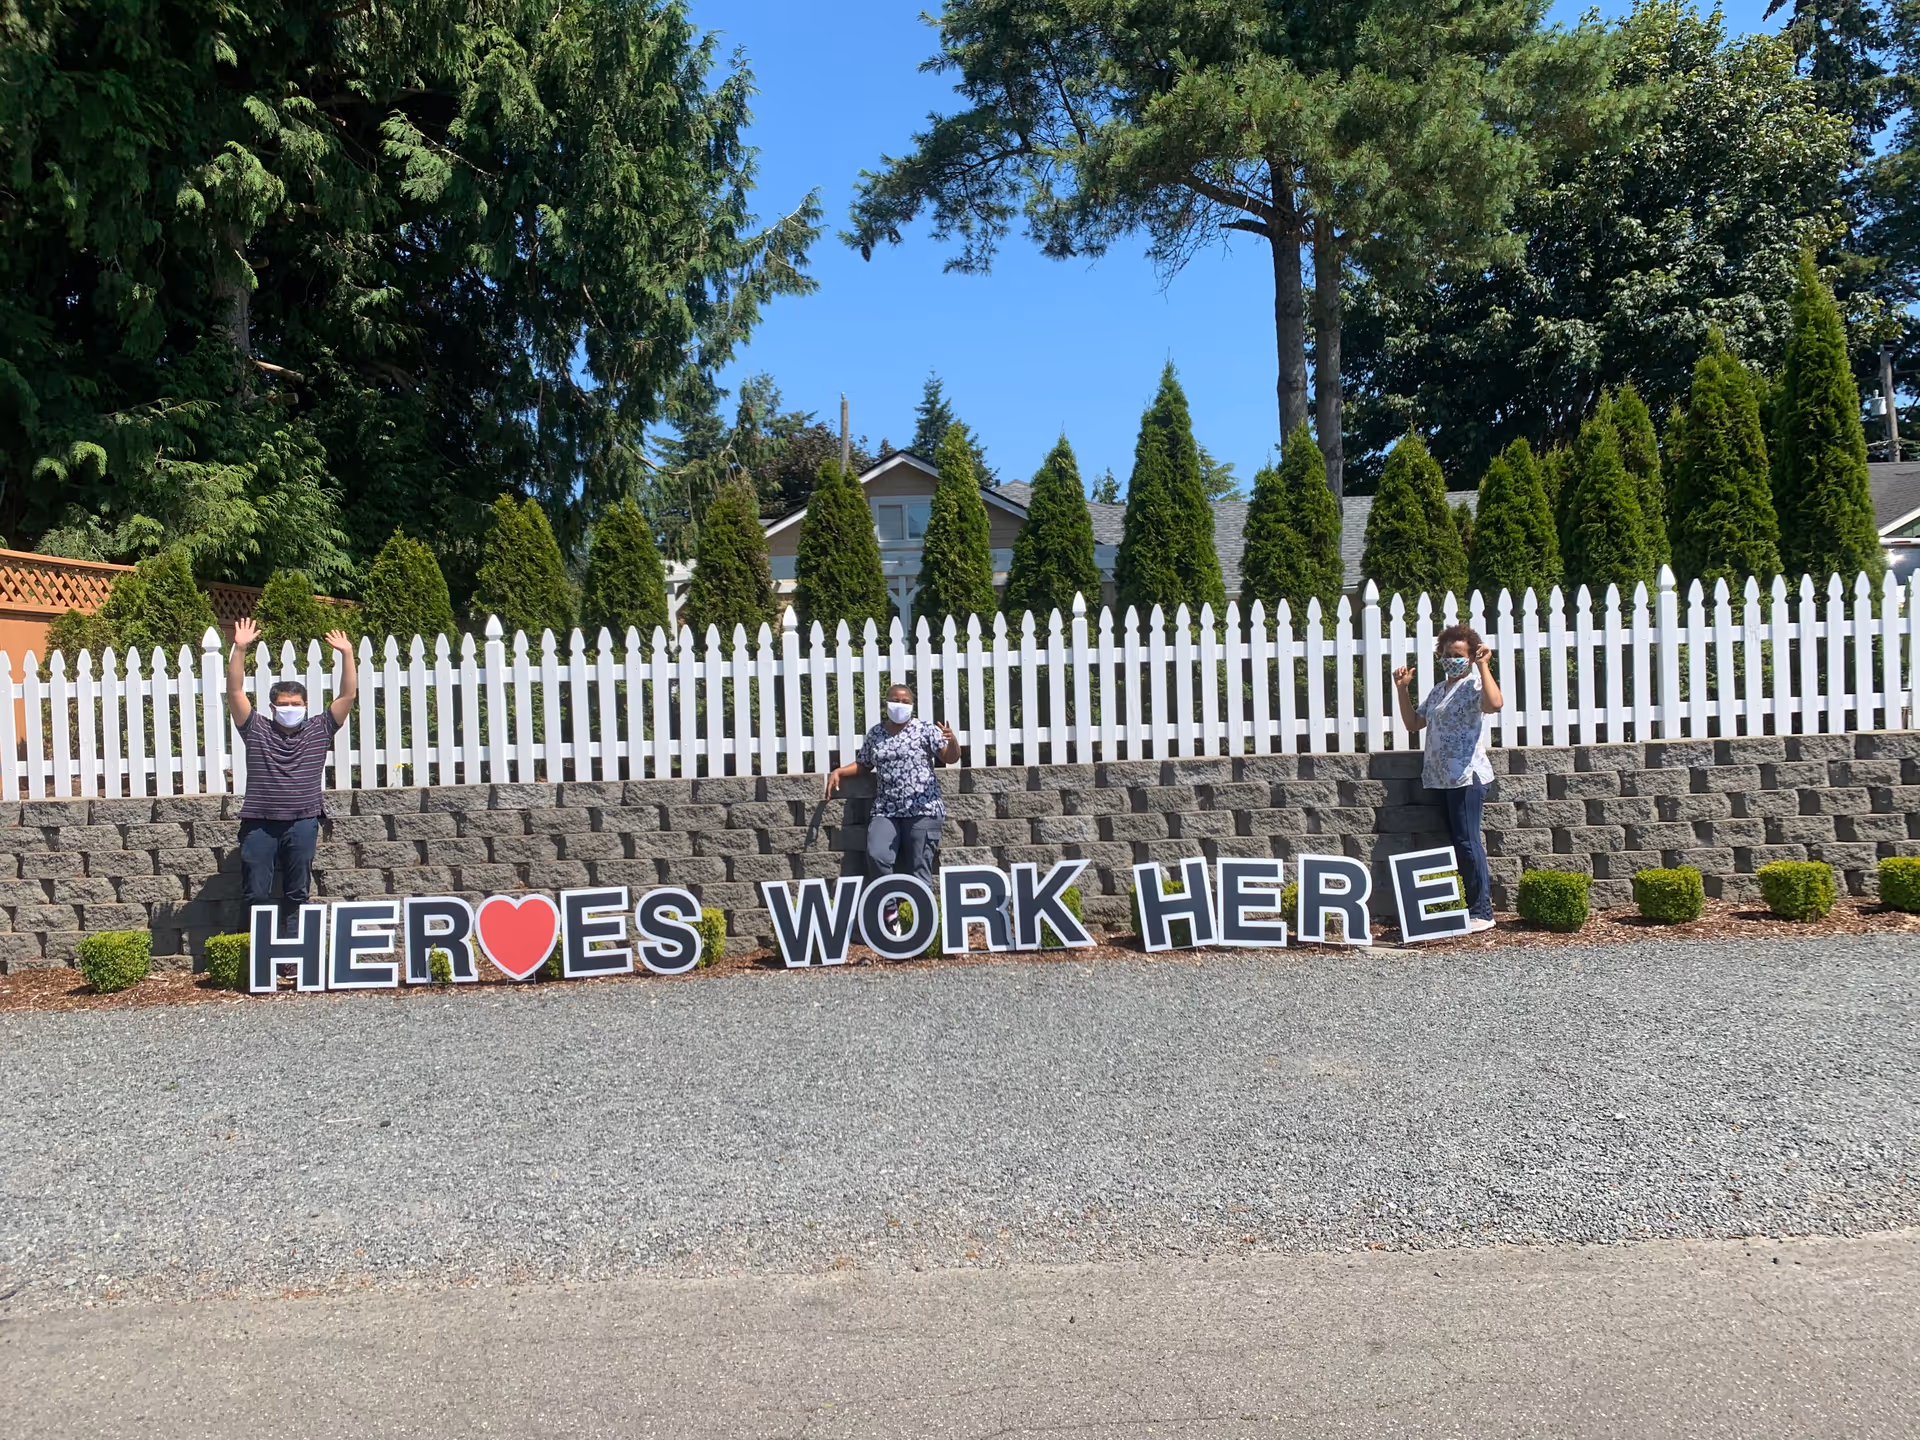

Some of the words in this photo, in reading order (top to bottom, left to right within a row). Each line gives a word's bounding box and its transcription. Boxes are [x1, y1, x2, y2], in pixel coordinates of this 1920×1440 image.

[250, 886, 703, 993] HERES
[761, 859, 1097, 968] WORK
[1133, 846, 1472, 953] HERE
